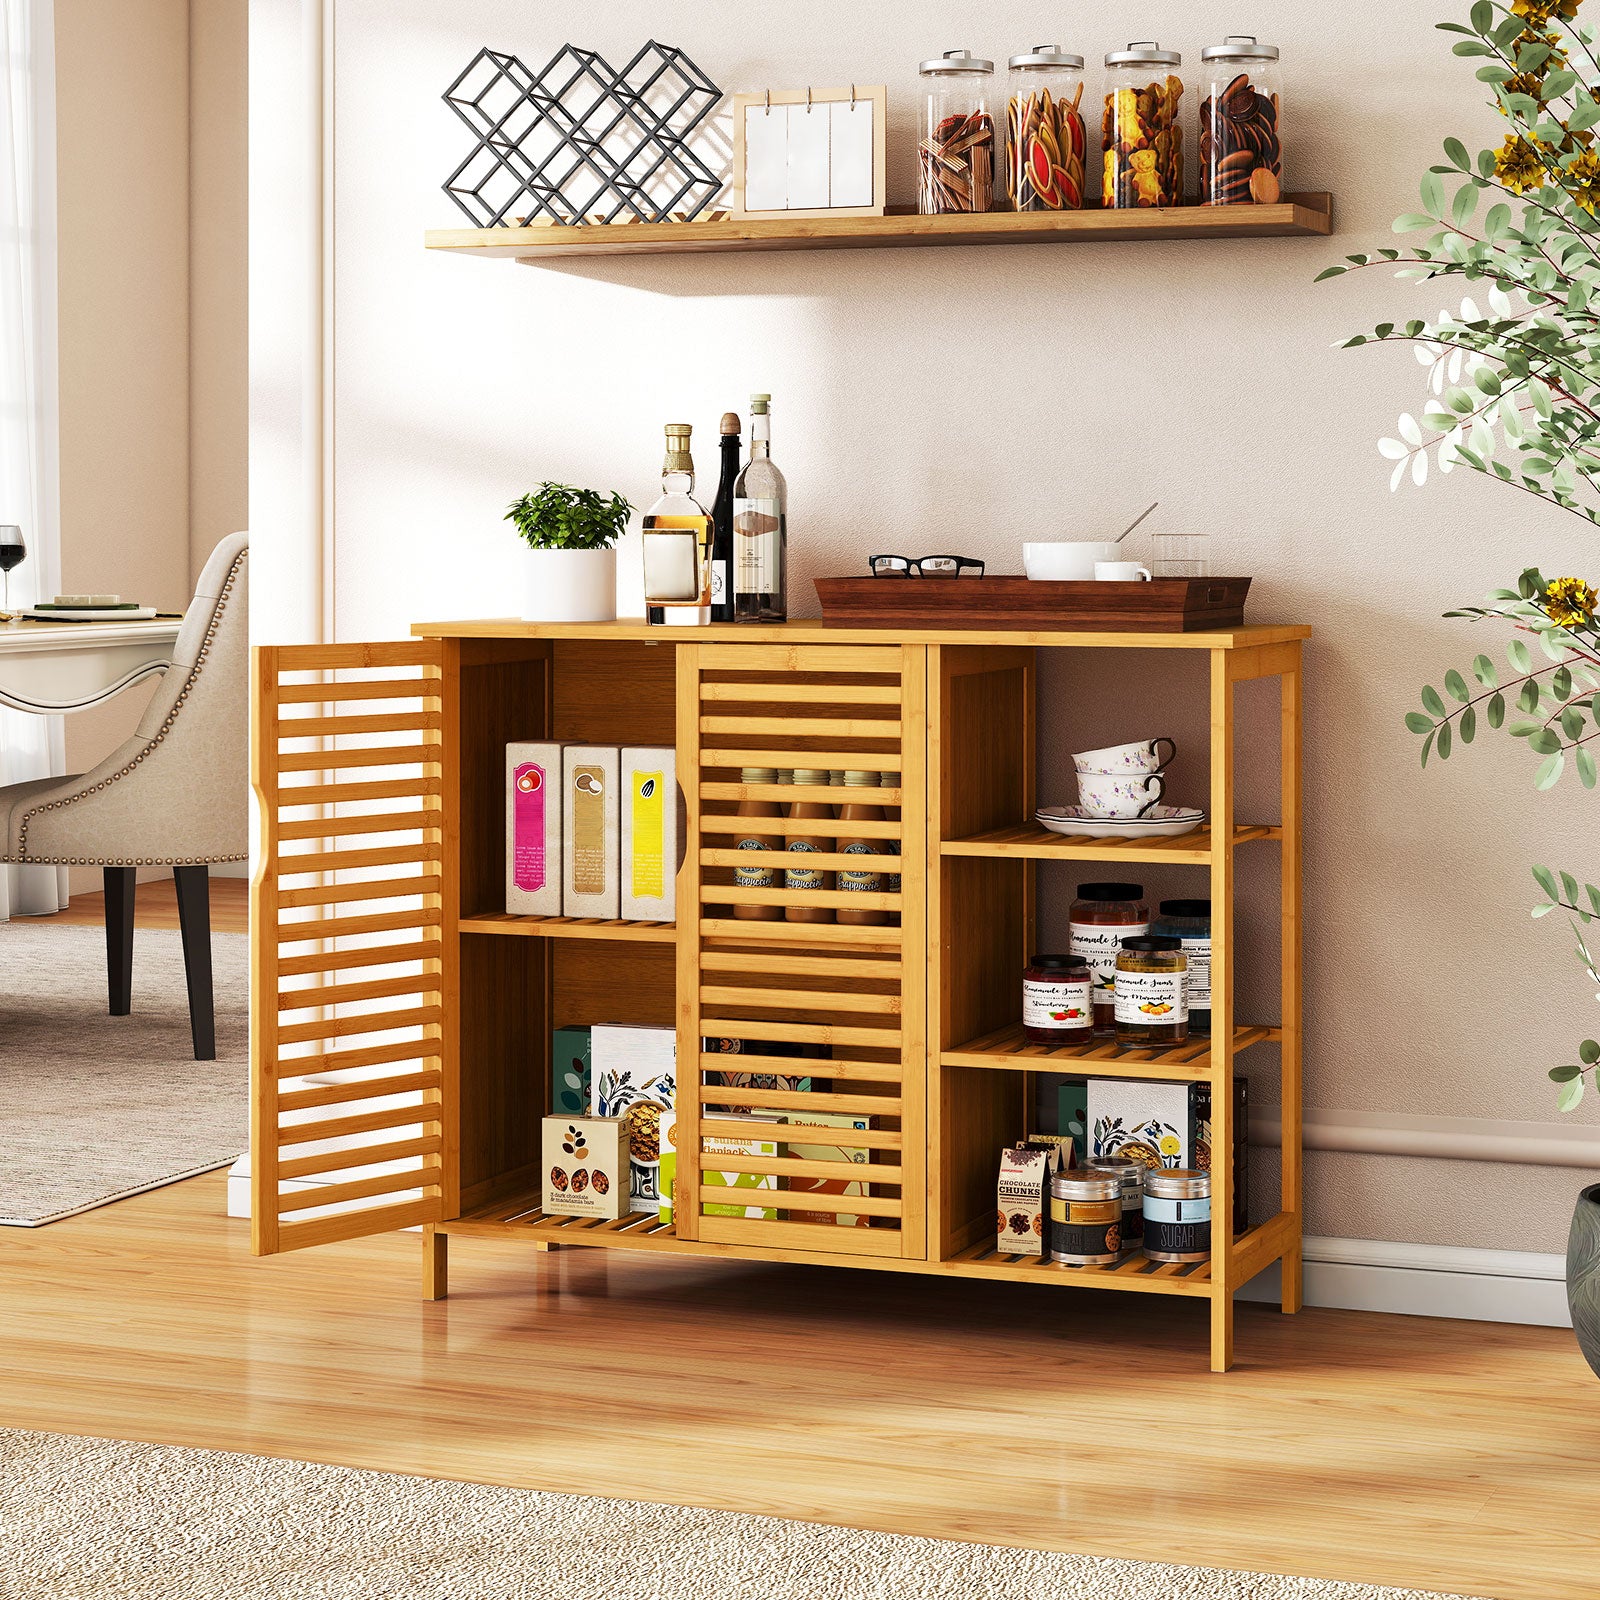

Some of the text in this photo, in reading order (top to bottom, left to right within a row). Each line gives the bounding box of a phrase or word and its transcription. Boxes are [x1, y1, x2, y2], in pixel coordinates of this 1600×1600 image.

[1150, 979, 1173, 988] Jams
[1000, 1180, 1041, 1188] CHOCOLATE
[999, 1186, 1041, 1196] CHUNKS
[1160, 1224, 1195, 1248] SUGAR
